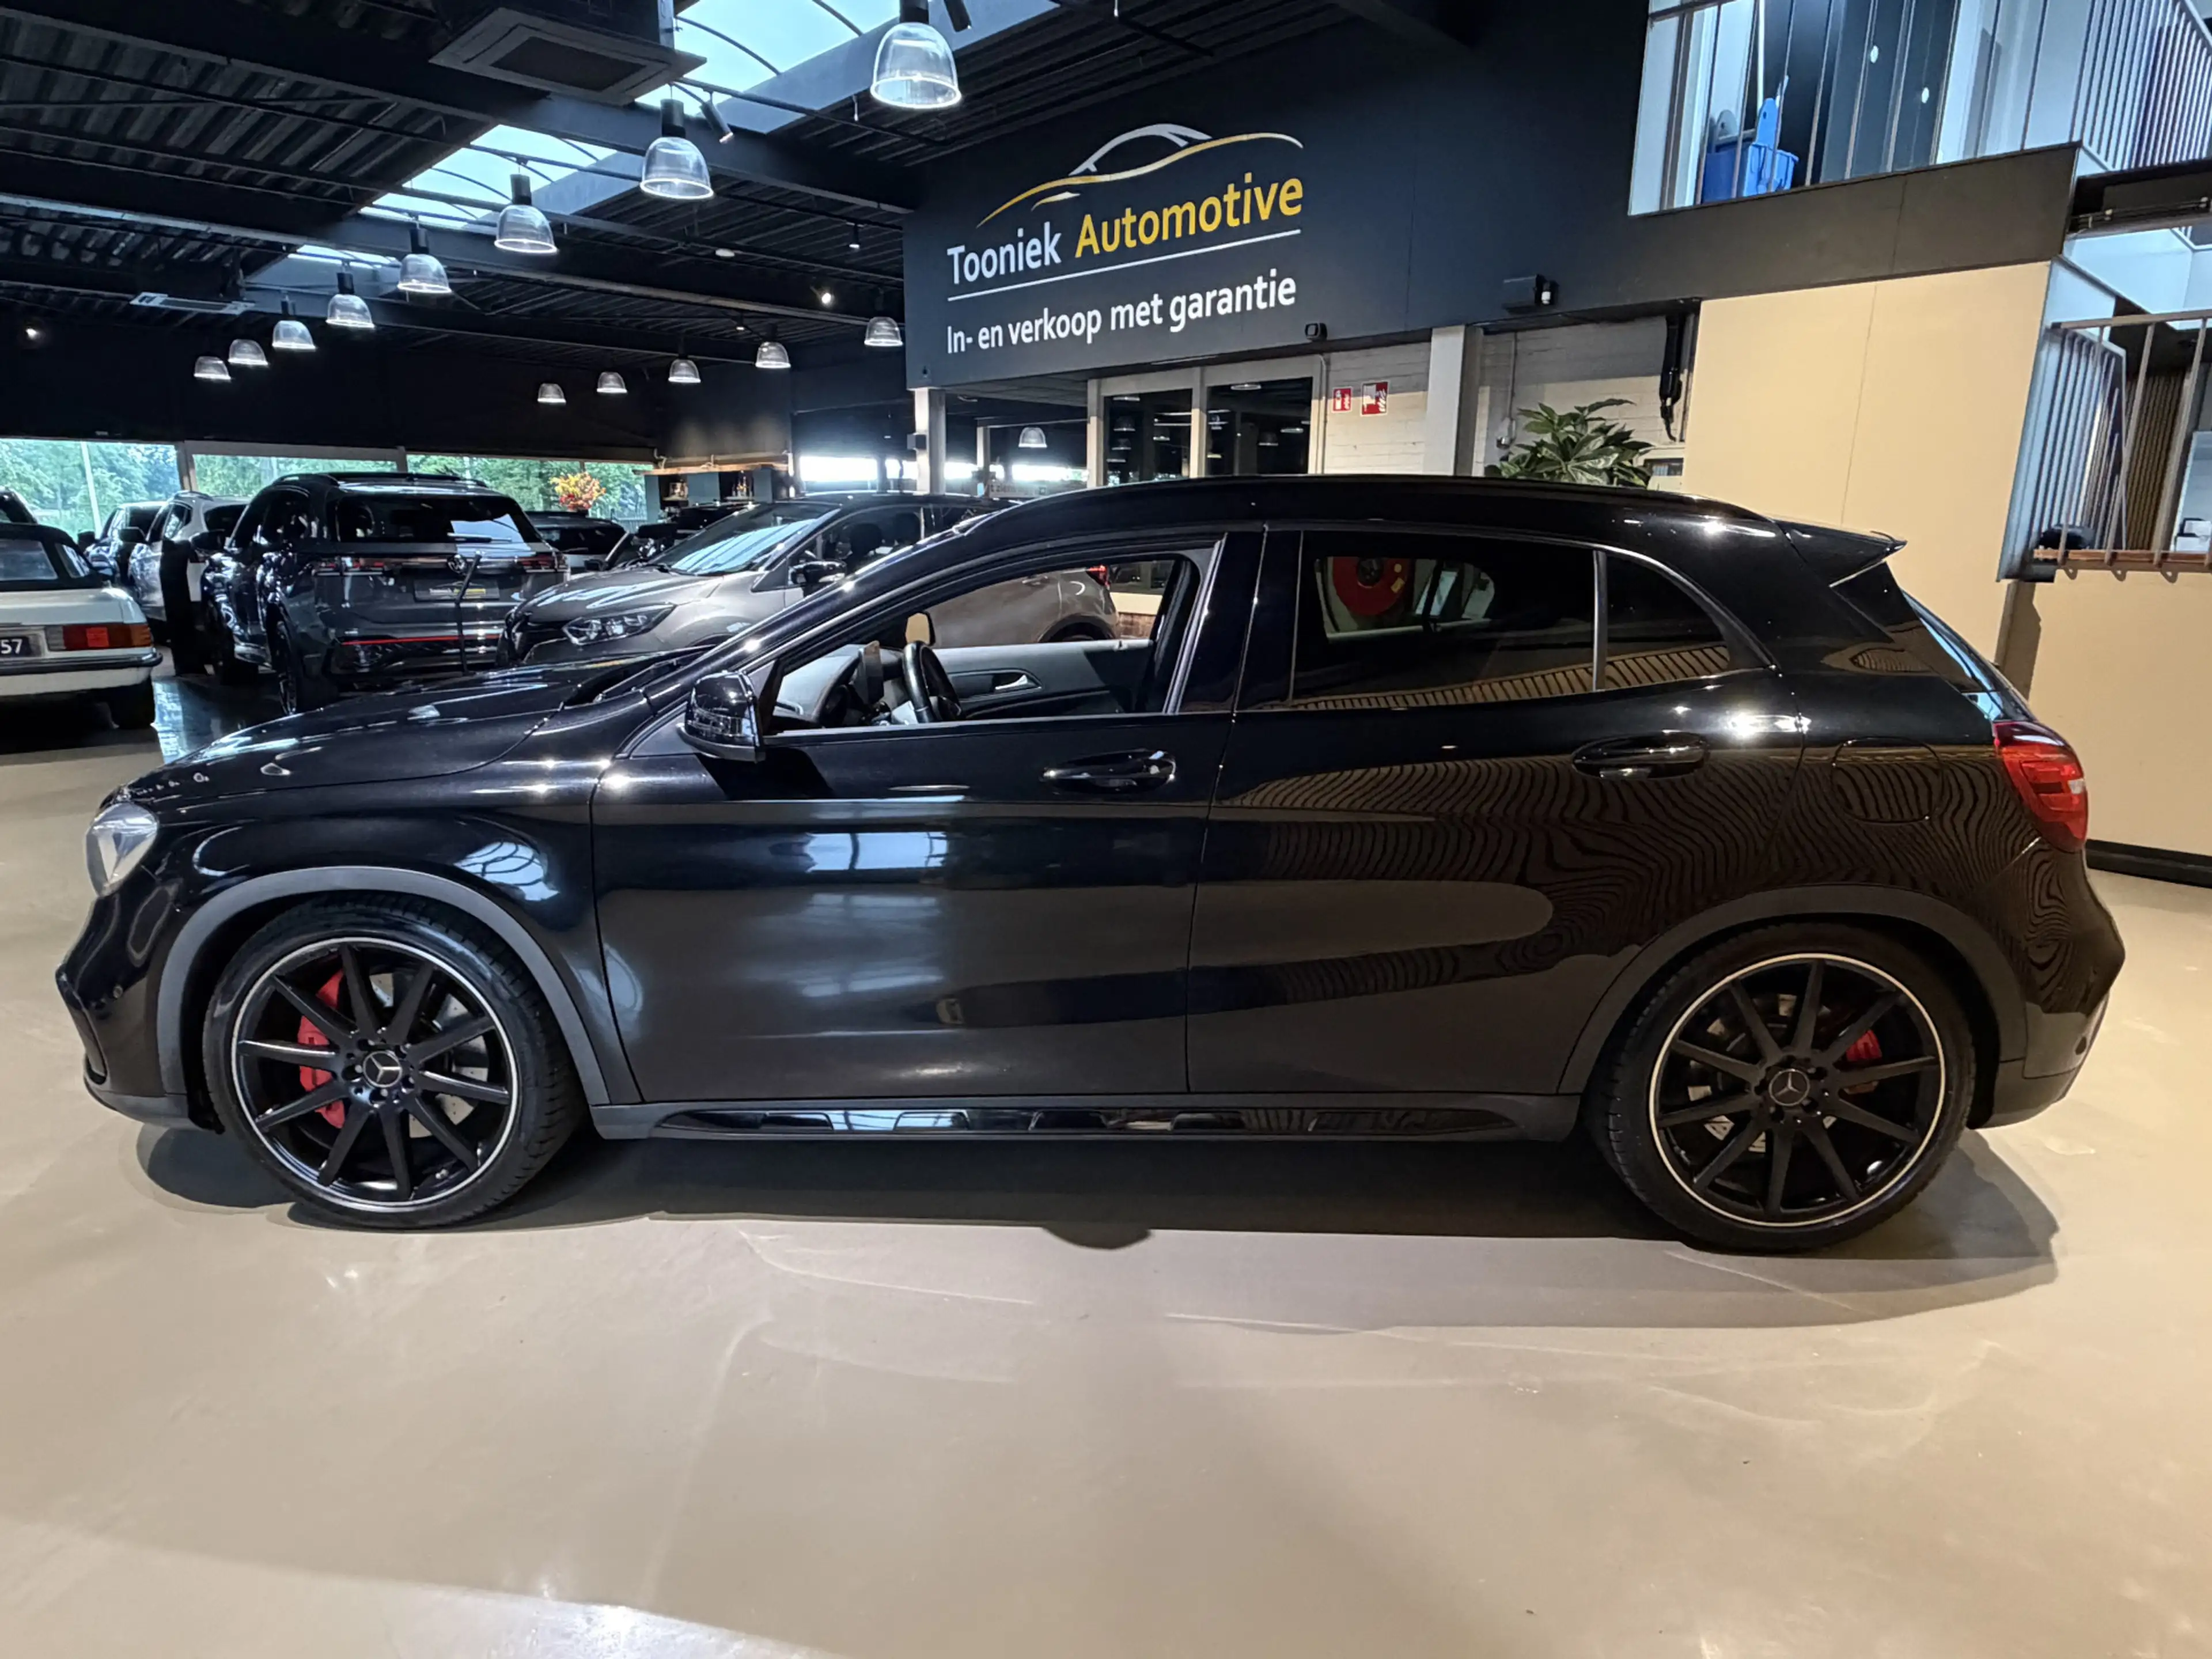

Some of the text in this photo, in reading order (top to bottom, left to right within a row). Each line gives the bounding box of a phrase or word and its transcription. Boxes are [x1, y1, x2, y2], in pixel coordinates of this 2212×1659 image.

[946, 172, 1303, 285] Tooniek Automotive
[947, 268, 1296, 354] In- en verkoop met garantie
[1, 638, 22, 654] 57
